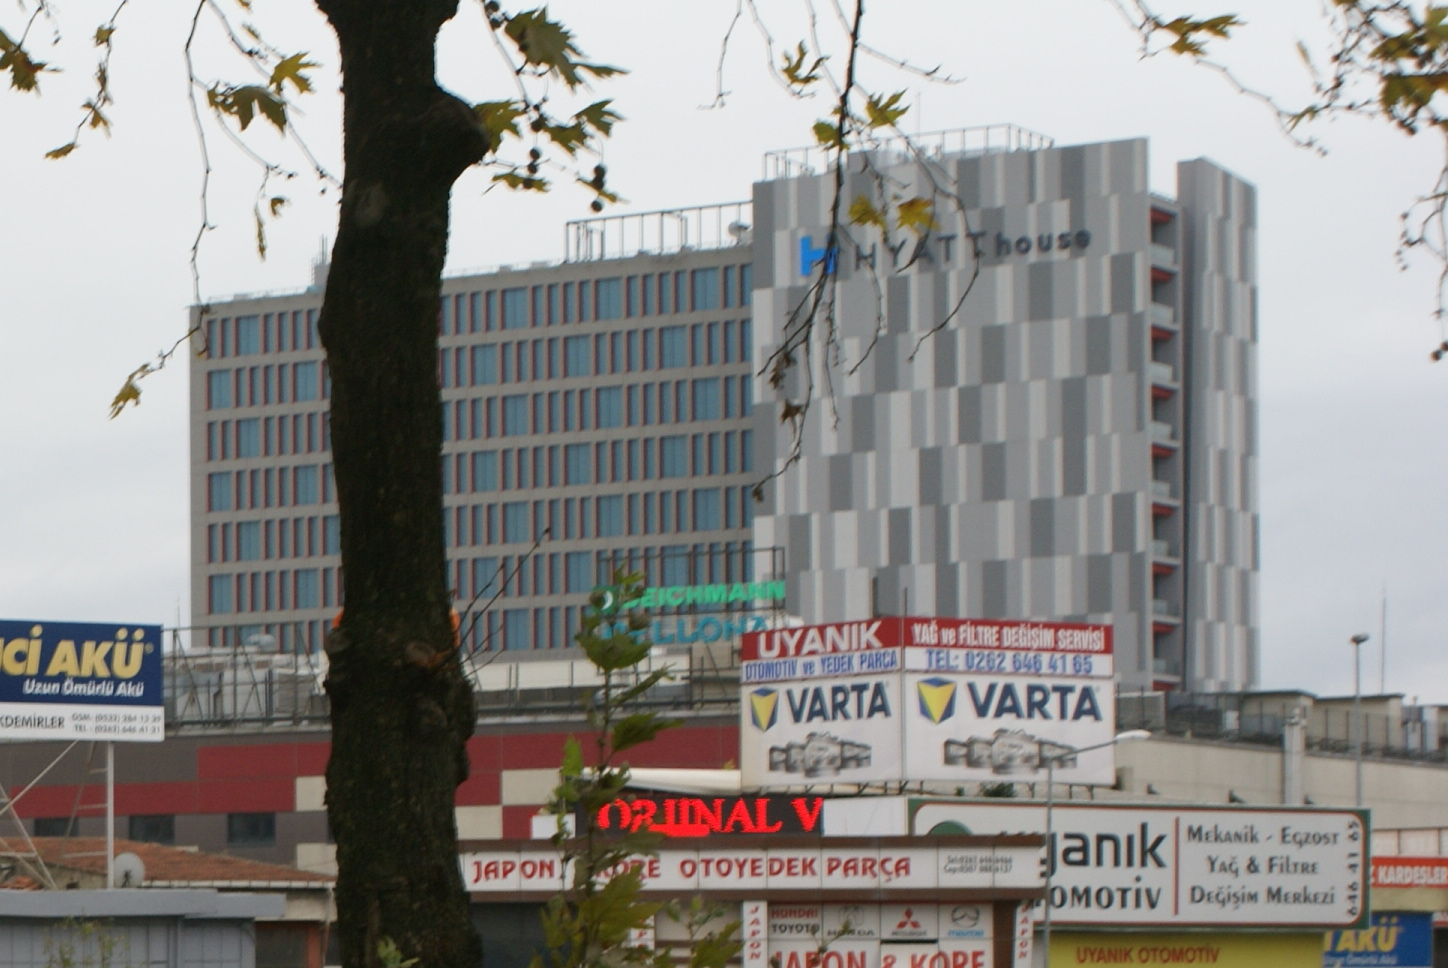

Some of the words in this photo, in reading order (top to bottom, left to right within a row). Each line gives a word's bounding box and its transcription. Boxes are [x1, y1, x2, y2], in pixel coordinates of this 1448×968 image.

[855, 230, 986, 271] HYATT
[995, 228, 1092, 259] house
[44, 627, 145, 679] AKÜ
[758, 620, 883, 659] UYANIK
[911, 620, 939, 645] YAĞ
[941, 627, 956, 645] ve
[958, 621, 1001, 648] FİLTRE
[1057, 626, 1106, 651] SERVİSİ
[802, 660, 815, 675] ve
[820, 654, 854, 674] YEDEK
[926, 649, 959, 670] TEL:
[964, 651, 1007, 672] 0262
[1012, 654, 1043, 673] 646
[1048, 655, 1068, 674] 41
[1073, 655, 1093, 675] 65
[23, 677, 59, 695] Uzun
[61, 677, 114, 697] Ömürlü
[114, 680, 145, 697] Akü
[786, 681, 891, 724] VARTA
[967, 681, 1103, 721] VARTA
[790, 797, 824, 832] V
[473, 859, 555, 883] JAPON
[826, 857, 911, 882] PARÇA
[1246, 854, 1260, 875] &
[1049, 875, 1162, 910] OMOTİV
[1336, 916, 1401, 952] AKÜ
[1076, 946, 1134, 964] UYANIK
[1138, 943, 1220, 964] OTOMOTİV
